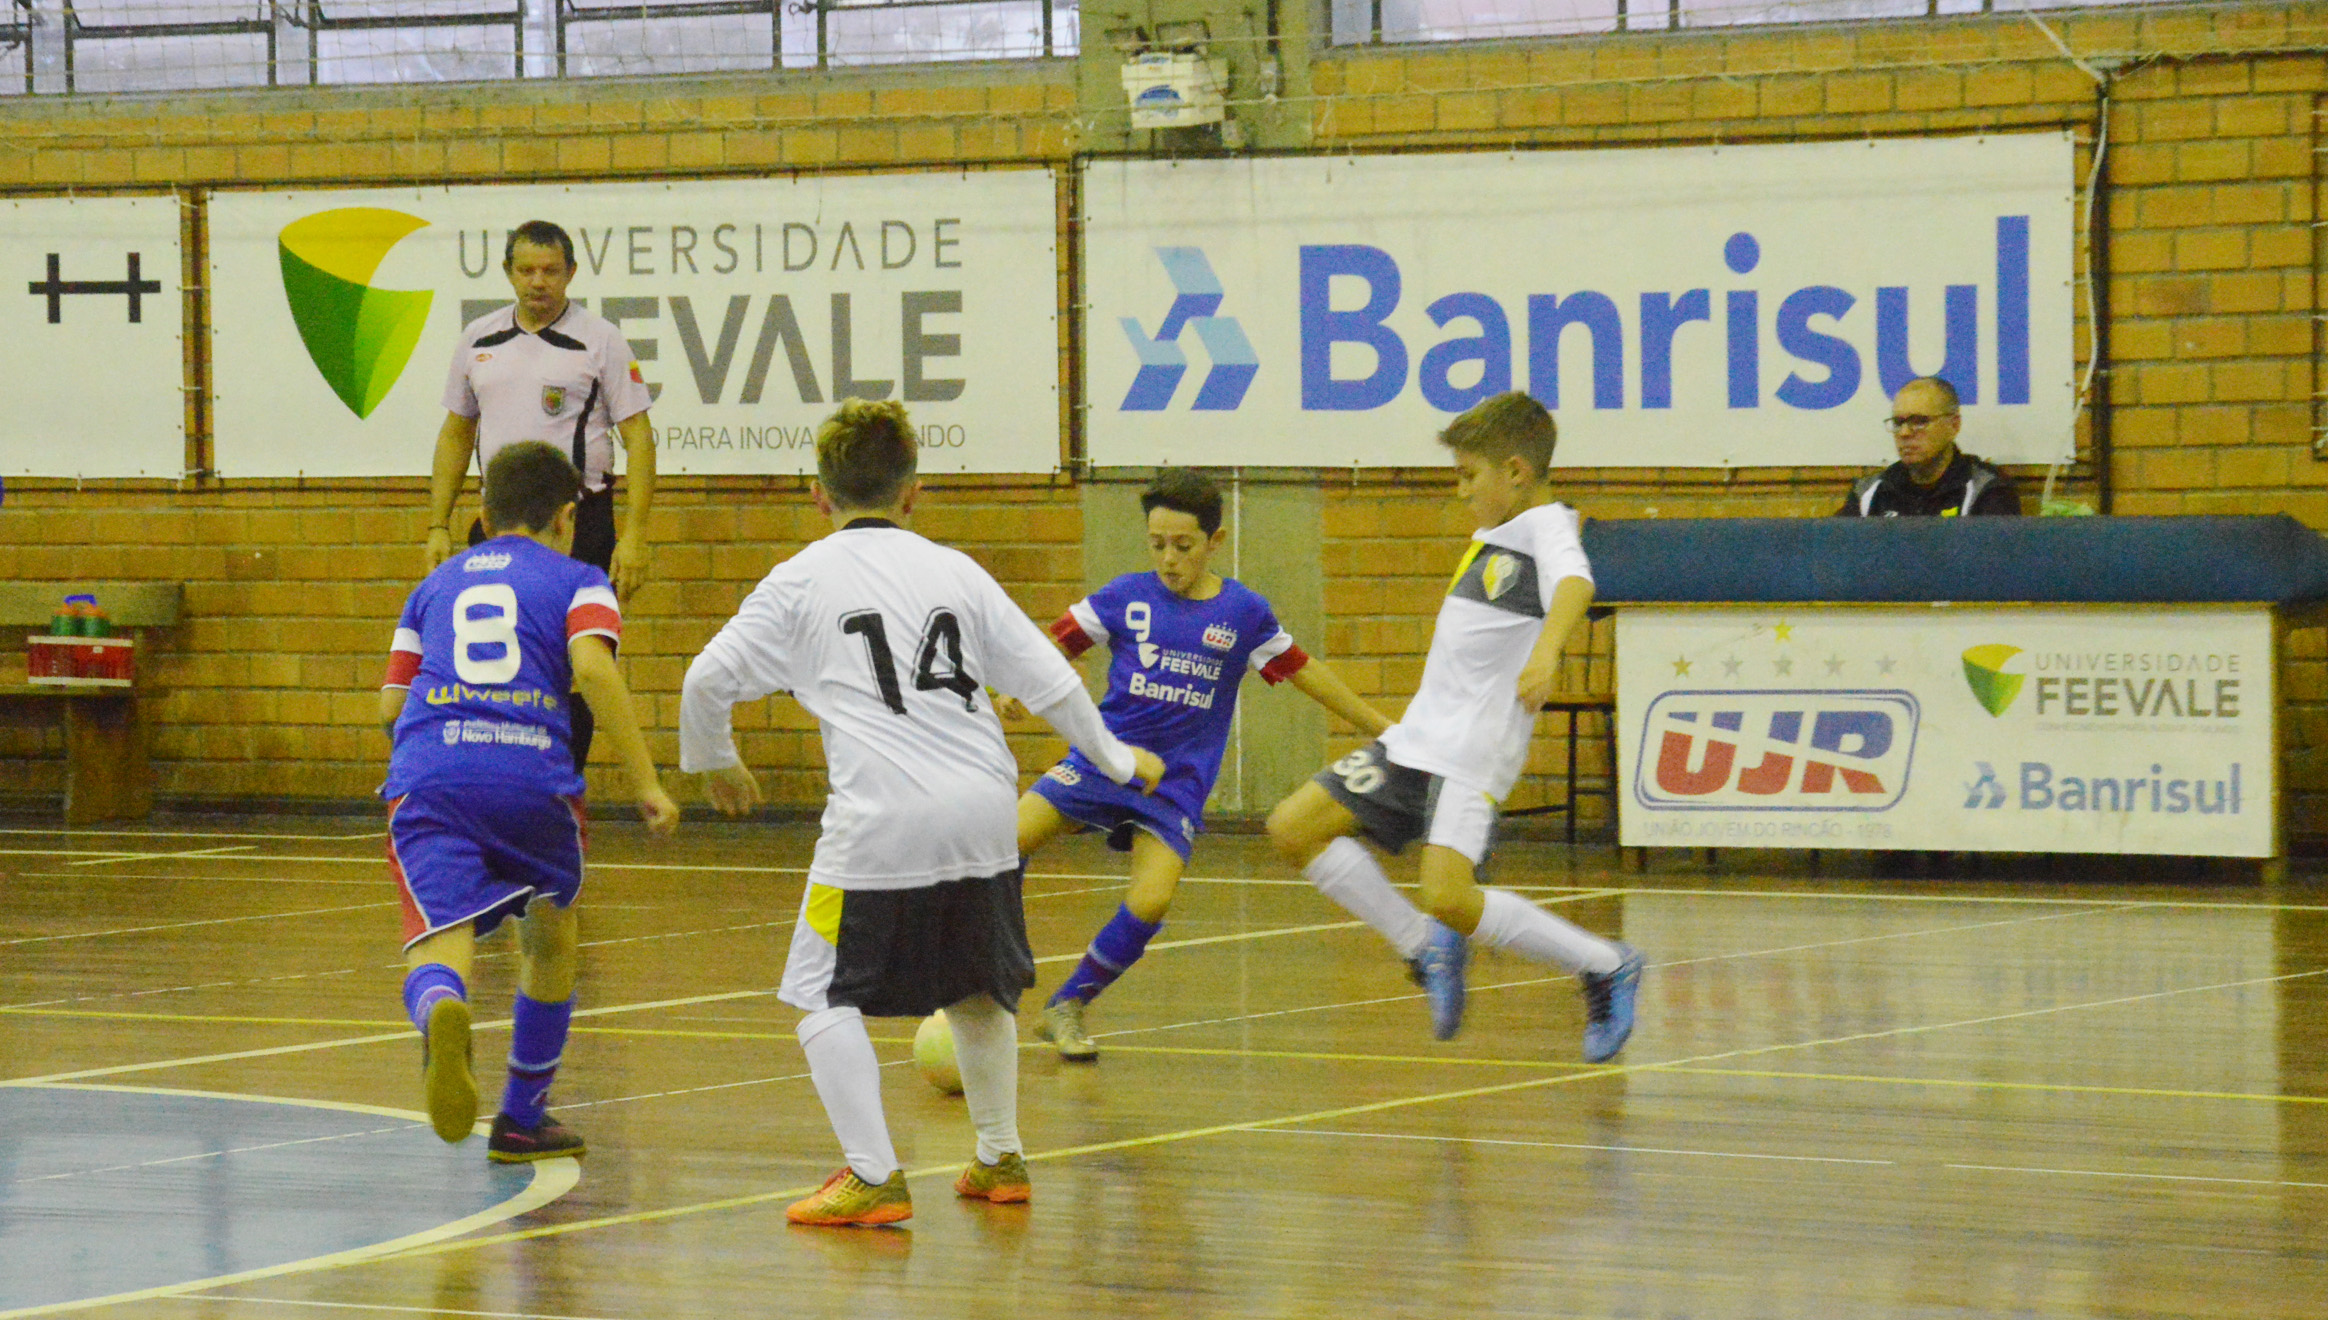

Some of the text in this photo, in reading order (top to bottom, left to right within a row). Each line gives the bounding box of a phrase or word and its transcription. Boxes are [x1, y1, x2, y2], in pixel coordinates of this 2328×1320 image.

[459, 218, 963, 278] UVERSIDADE
[1299, 215, 2030, 411] Banrisul
[667, 426, 733, 450] PARA
[740, 426, 815, 450] INOVA
[452, 583, 521, 685] 8
[1125, 601, 1151, 643] 9
[837, 606, 979, 715] 14
[1160, 656, 1221, 680] FEEVALE
[2035, 653, 2240, 672] UNIVERSIDADE
[1128, 672, 1215, 709] Banrisul
[2036, 677, 2241, 717] FEEVALE
[462, 729, 493, 743] Novo
[1656, 710, 1893, 796] UJR
[1333, 750, 1386, 793] 30
[2020, 762, 2241, 814] Banrisul
[1753, 821, 1776, 838] DO
